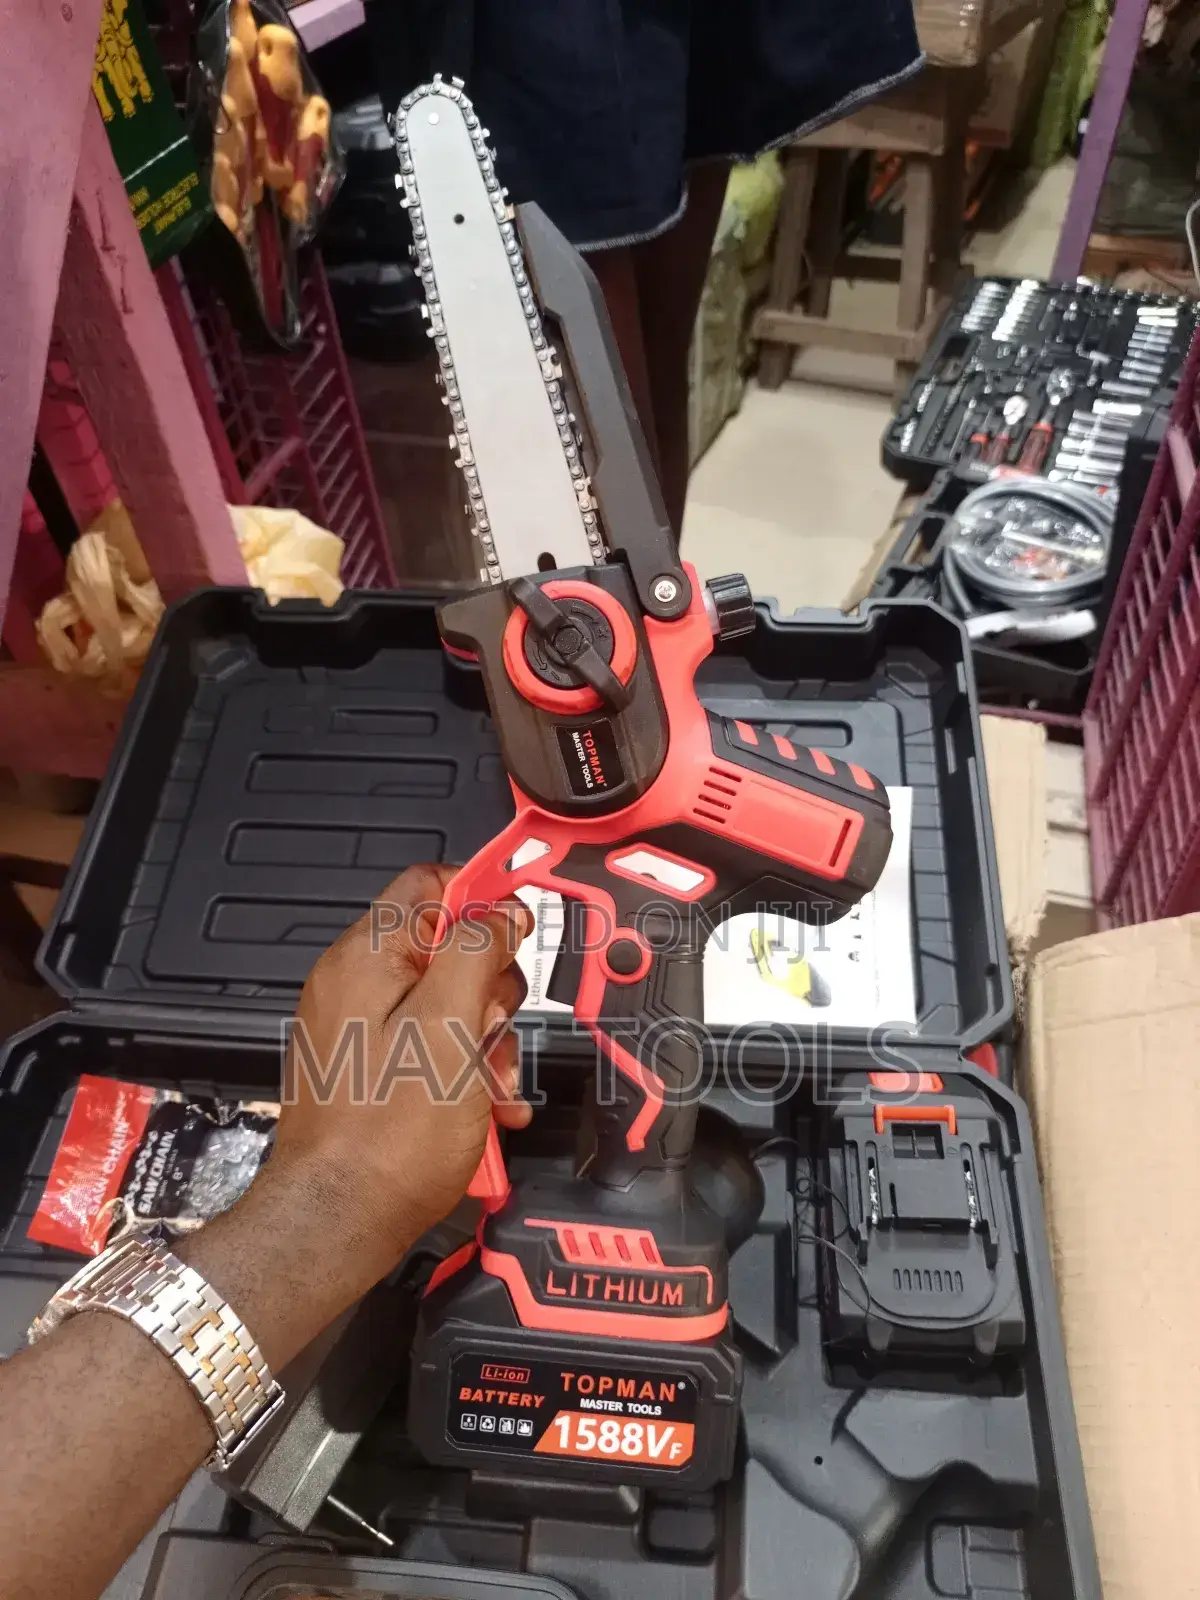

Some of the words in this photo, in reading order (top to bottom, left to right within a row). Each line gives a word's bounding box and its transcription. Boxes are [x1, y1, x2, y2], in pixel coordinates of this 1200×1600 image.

[572, 732, 586, 762] MASTER
[582, 764, 593, 789] TOOLS
[530, 958, 543, 1006] Lithium
[87, 1177, 108, 1216] SAW
[103, 1120, 129, 1175] CHAIN
[137, 1179, 158, 1214] SAW
[546, 1270, 684, 1306] LITHIUM
[484, 1365, 526, 1382] Li-ion
[459, 1387, 546, 1408] BATTERY
[580, 1398, 623, 1413] MASTER
[627, 1402, 662, 1416] TOOLS
